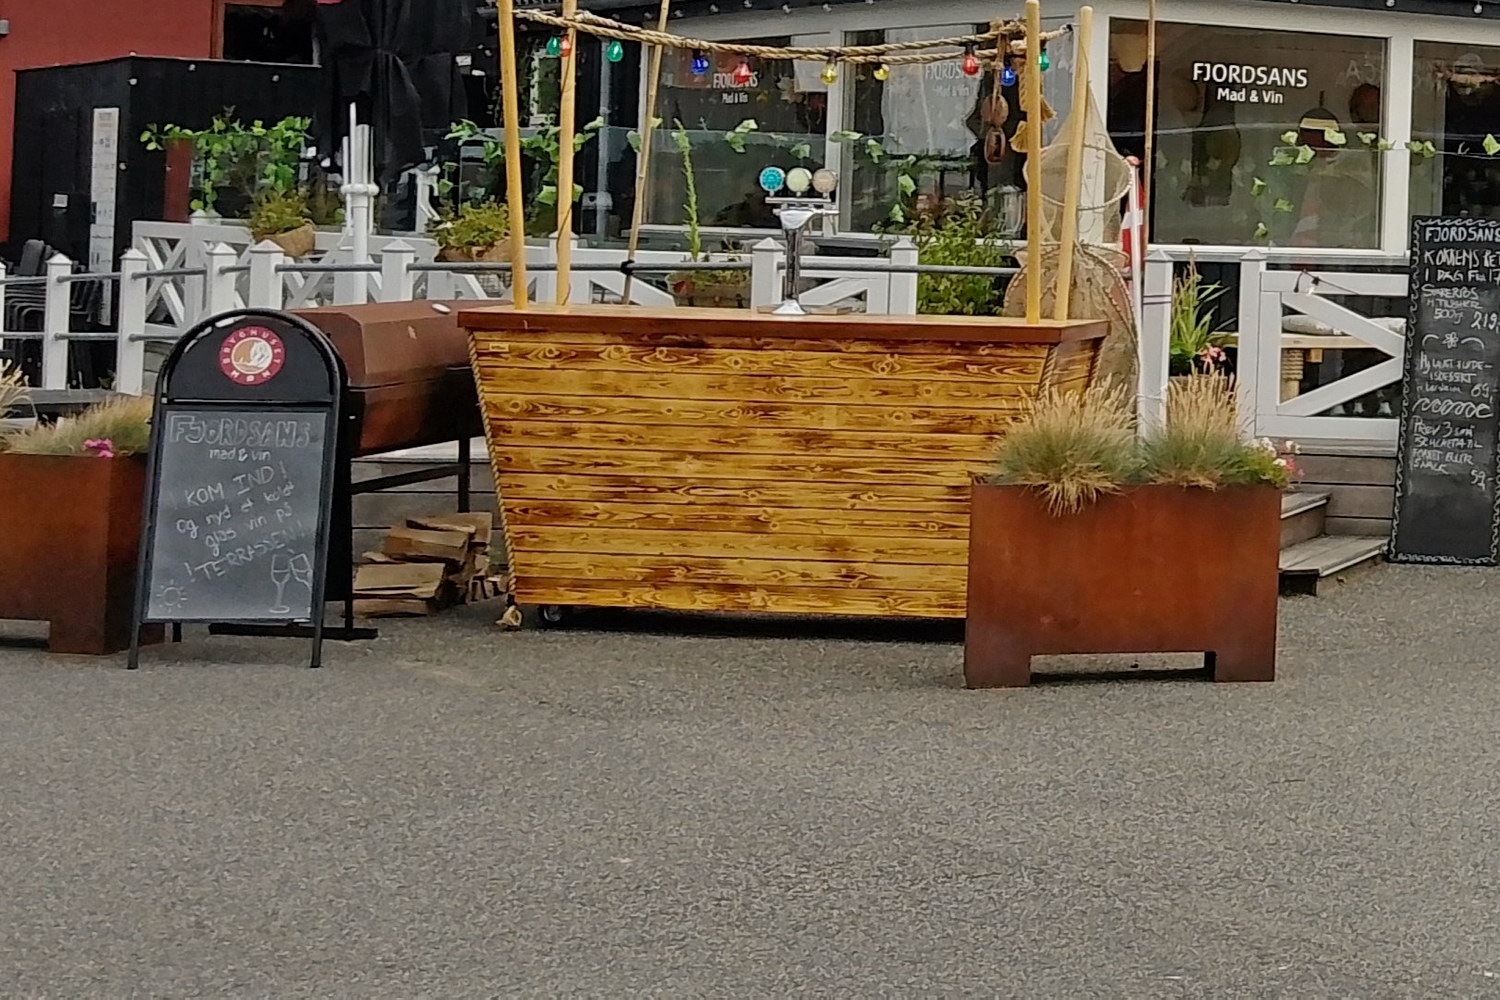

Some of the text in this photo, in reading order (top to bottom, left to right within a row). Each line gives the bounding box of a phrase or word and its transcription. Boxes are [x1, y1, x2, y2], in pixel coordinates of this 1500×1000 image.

[713, 71, 758, 89] FJORNS
[925, 61, 983, 80] FJORDS
[1192, 62, 1308, 88] FJORDSANS
[1217, 88, 1283, 104] Mad & Vin
[1437, 269, 1464, 282] DAG
[170, 415, 311, 448] FJORDSANS
[1442, 421, 1452, 438] 3
[209, 448, 236, 460] mad
[251, 450, 271, 460] vin
[185, 482, 225, 506] KOM
[206, 504, 231, 525] nyd
[205, 502, 292, 557] glas vin på
